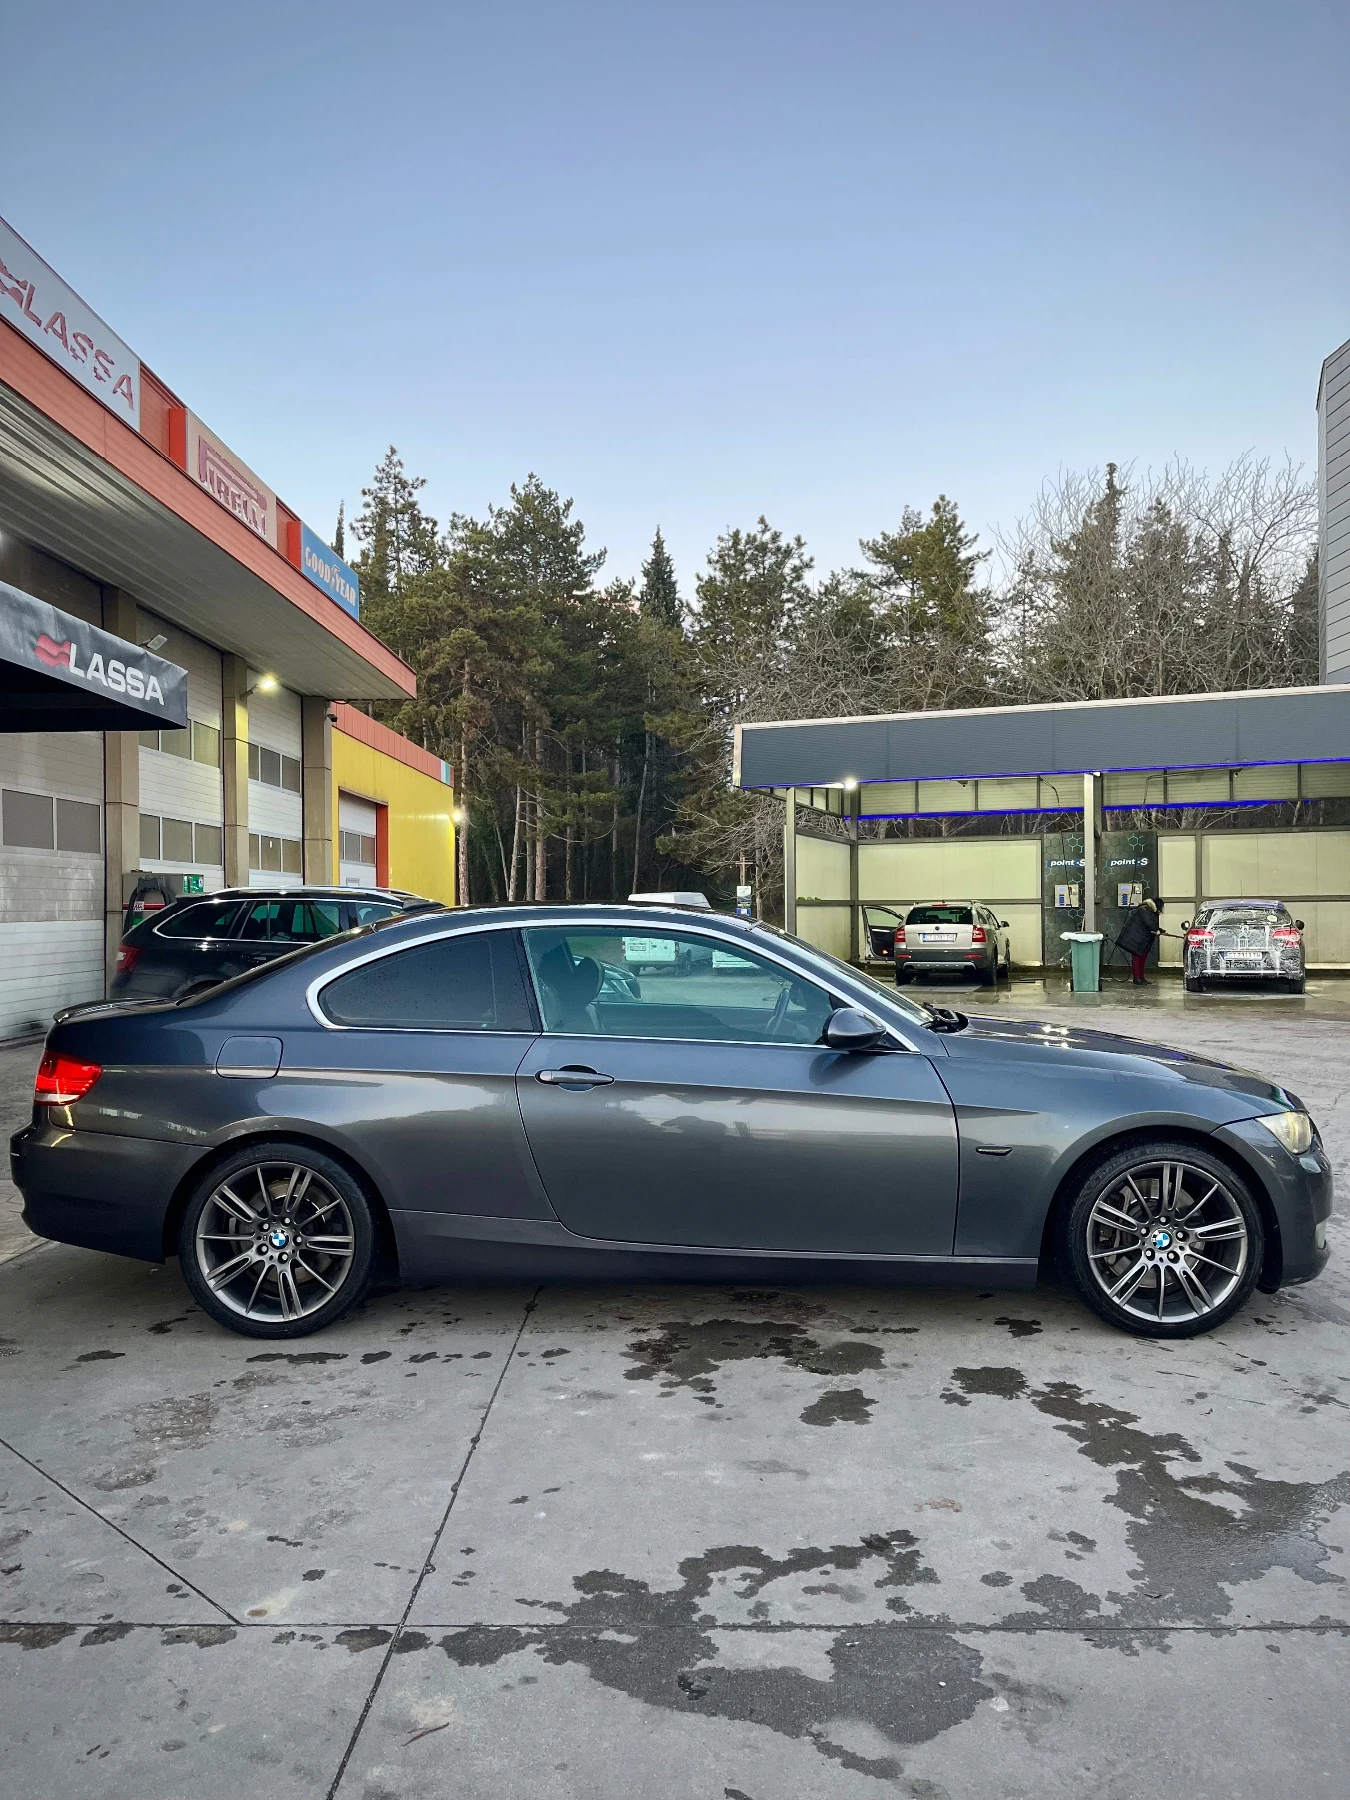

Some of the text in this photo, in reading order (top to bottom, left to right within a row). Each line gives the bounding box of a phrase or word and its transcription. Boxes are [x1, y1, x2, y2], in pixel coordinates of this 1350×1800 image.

[24, 283, 134, 411] LASSA
[304, 546, 356, 606] GOODYEAR
[69, 642, 165, 706] LASSA
